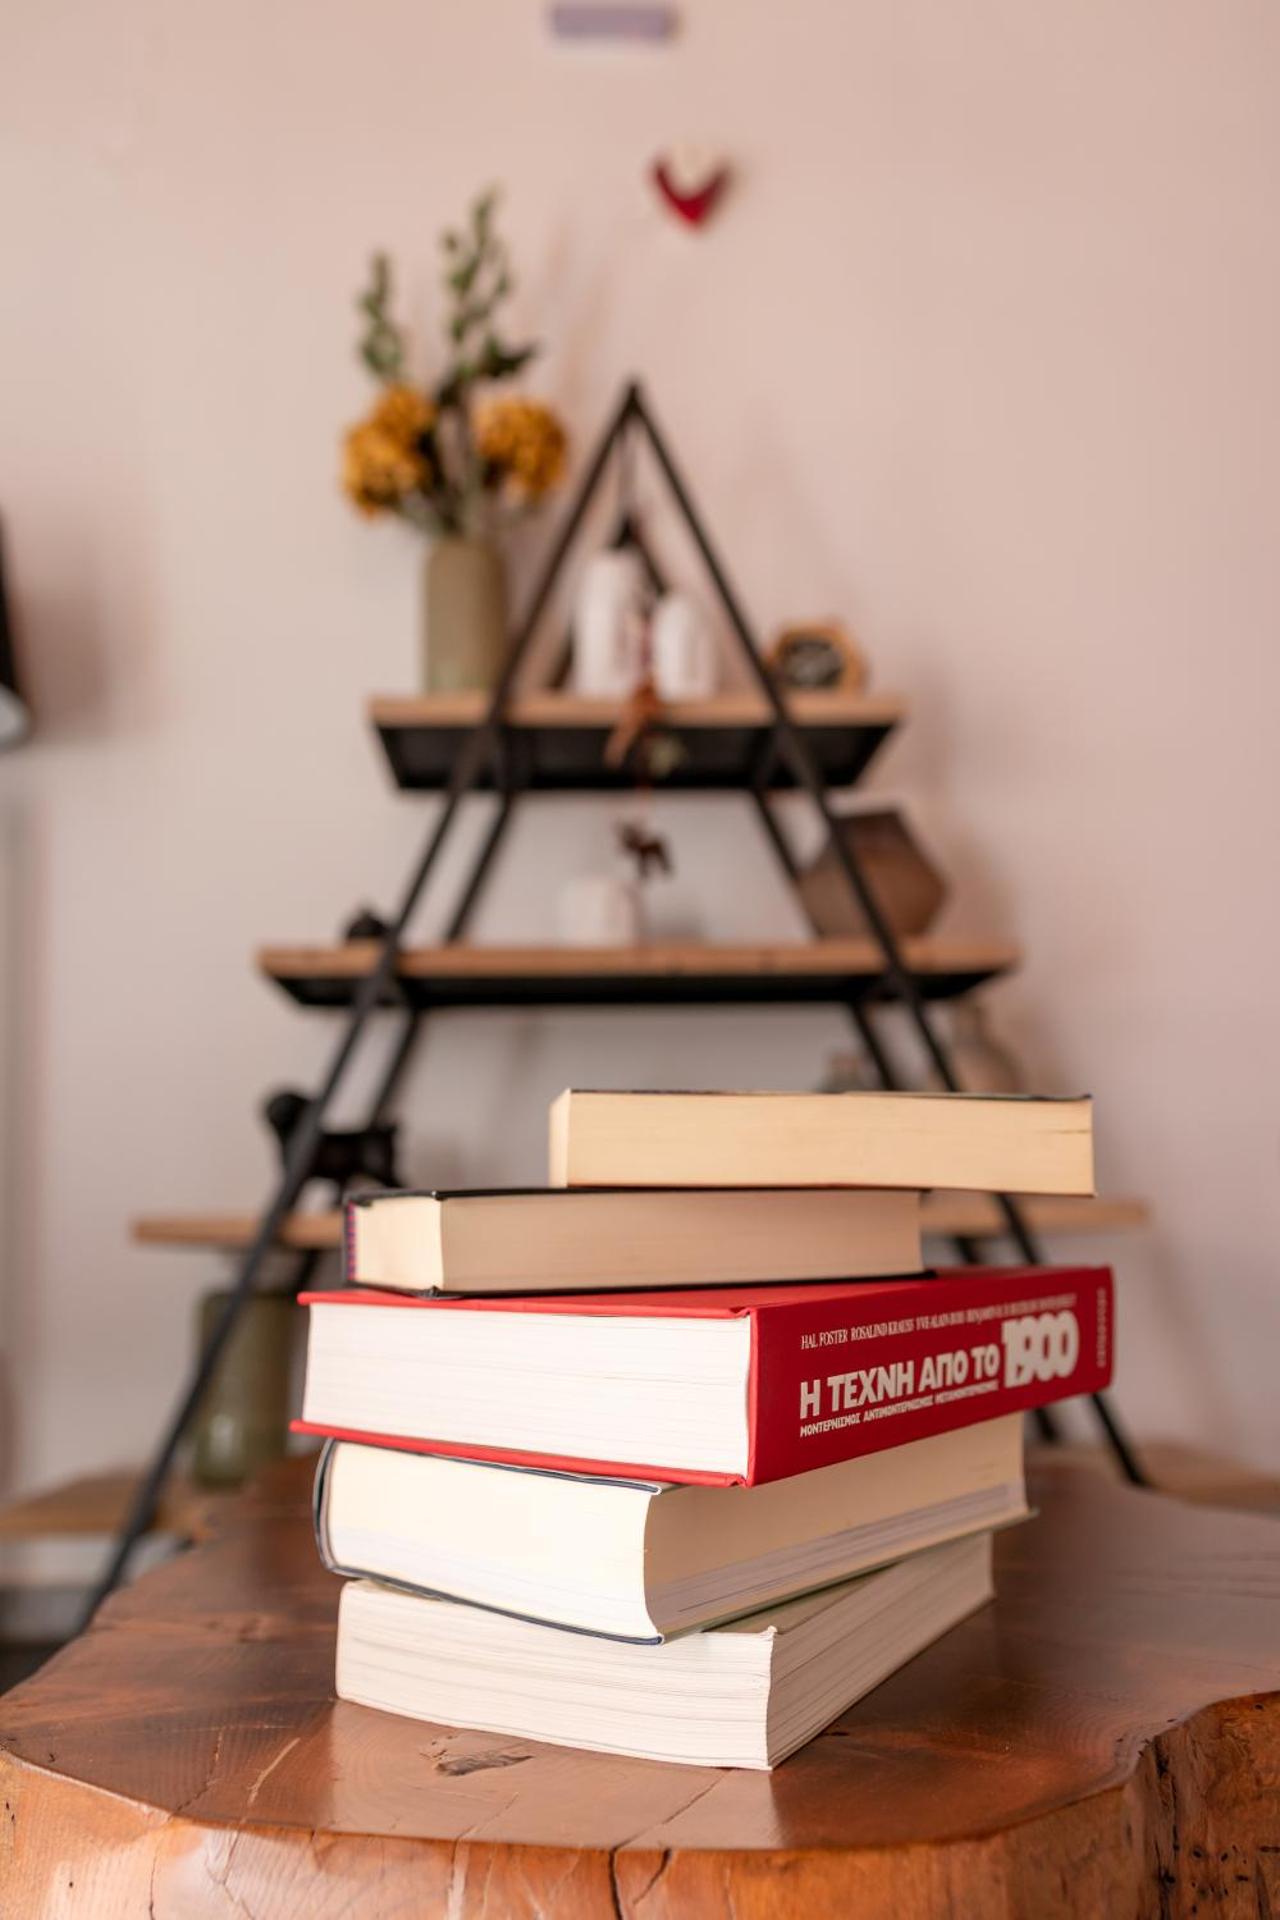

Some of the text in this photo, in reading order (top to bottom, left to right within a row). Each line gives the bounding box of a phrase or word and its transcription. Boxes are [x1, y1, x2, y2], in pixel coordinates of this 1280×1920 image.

[800, 1333, 818, 1350] HAL
[819, 1328, 848, 1347] FOSTER
[850, 1322, 888, 1341] ROSALIND
[888, 1318, 914, 1336] KRAUSS
[799, 1379, 821, 1419] Η
[827, 1360, 915, 1412] ΤΕΧΝΗ
[918, 1350, 969, 1392] ΑΠΟ
[971, 1344, 1000, 1380] ΤΟ
[1001, 1309, 1080, 1389] 1900
[799, 1412, 861, 1438] ΜΟΝΤΕΡΝΙΣΜΟΣ
